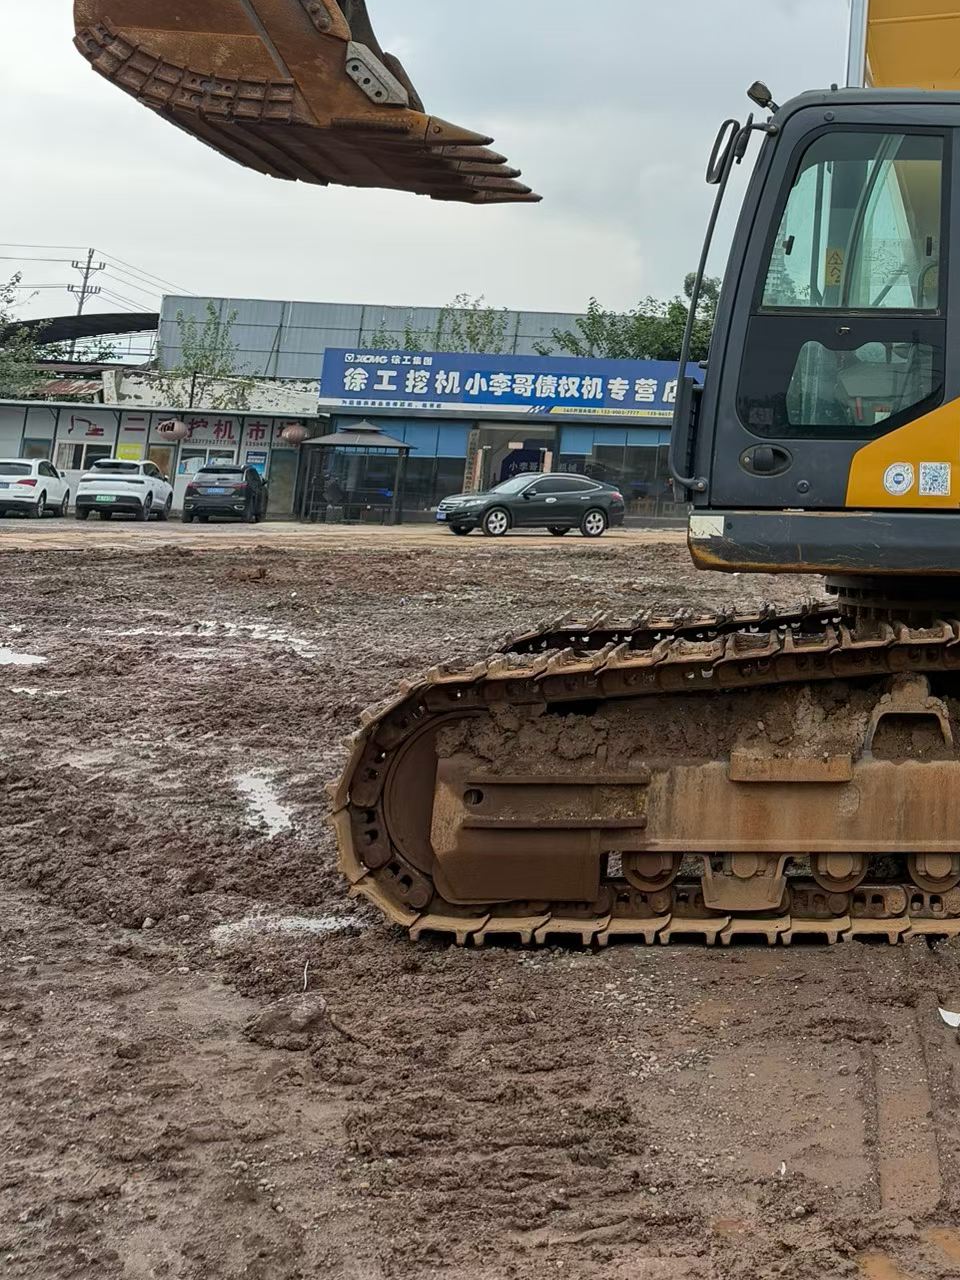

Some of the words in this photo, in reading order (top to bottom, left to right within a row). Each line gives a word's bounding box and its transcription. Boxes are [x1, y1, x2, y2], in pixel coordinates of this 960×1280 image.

[354, 354, 388, 365] XCMG
[391, 355, 433, 366] 徐工集团
